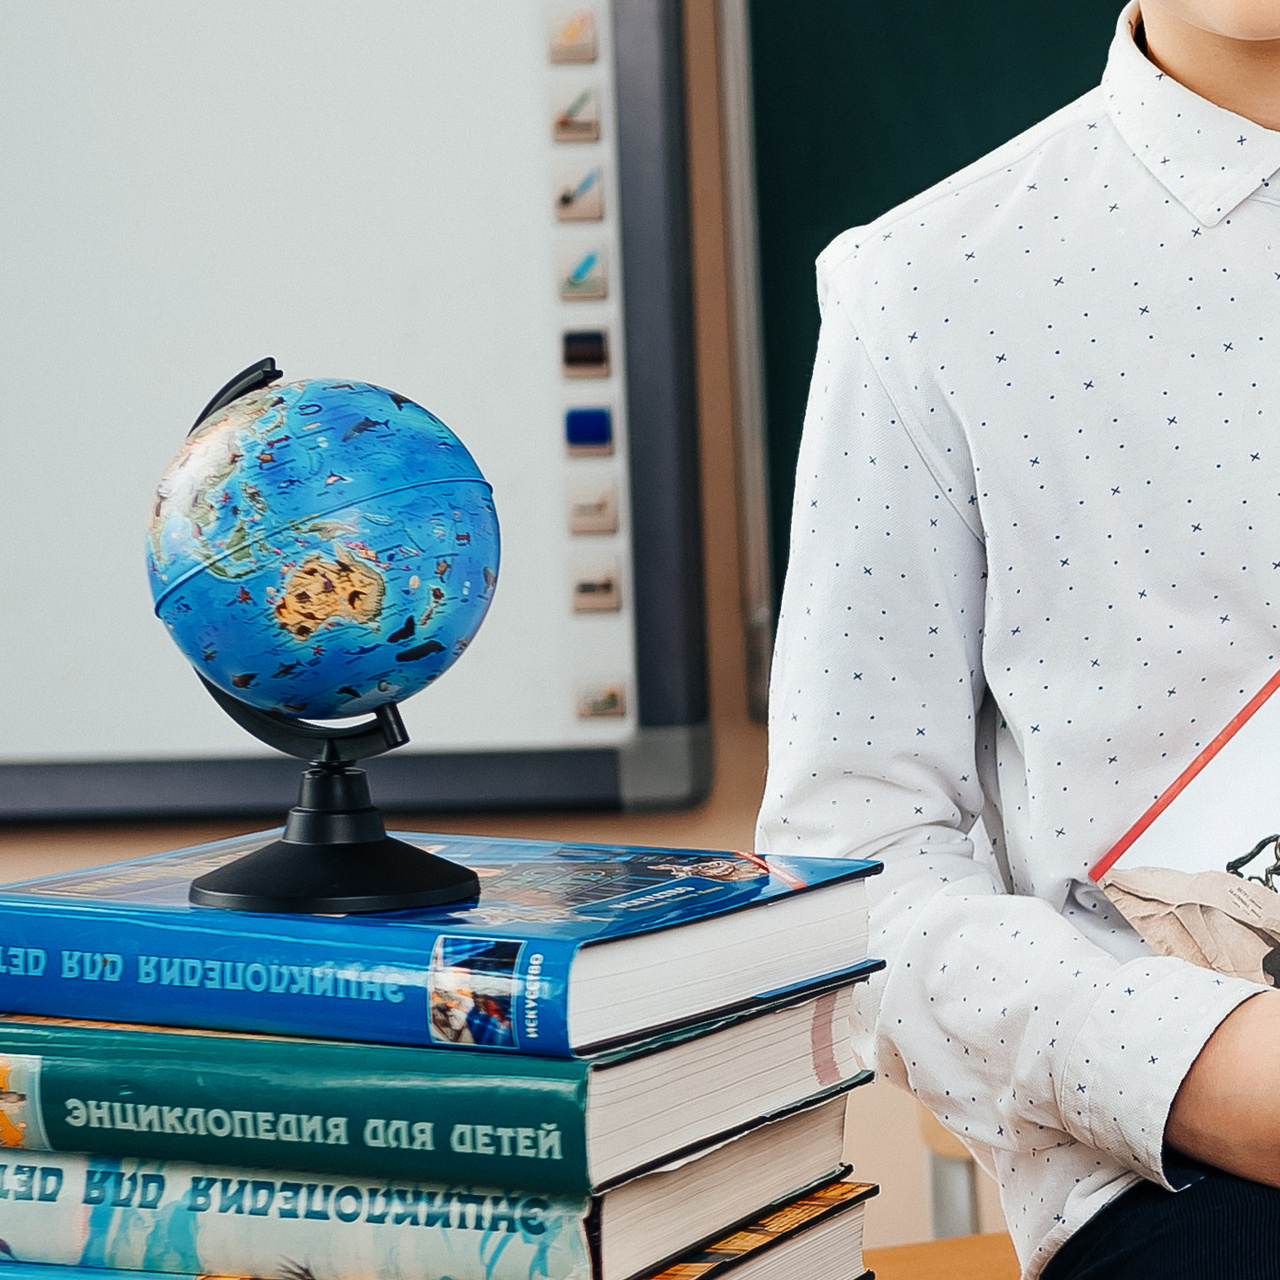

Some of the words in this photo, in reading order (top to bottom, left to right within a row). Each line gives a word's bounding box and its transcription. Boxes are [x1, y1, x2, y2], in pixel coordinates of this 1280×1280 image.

[60, 950, 124, 982] ДЛЯ
[137, 955, 406, 1003] ЭНЦИКЛОПЕДИЯ
[65, 1098, 350, 1145] ЭНЦИКЛОПЕДИЯ
[363, 1118, 436, 1151] ДЛЯ
[450, 1121, 565, 1160] ДЕТЕЙ
[83, 1169, 167, 1209] ДЛЯ
[187, 1175, 551, 1236] ЭНЦИКЛОПЕДИЯ
